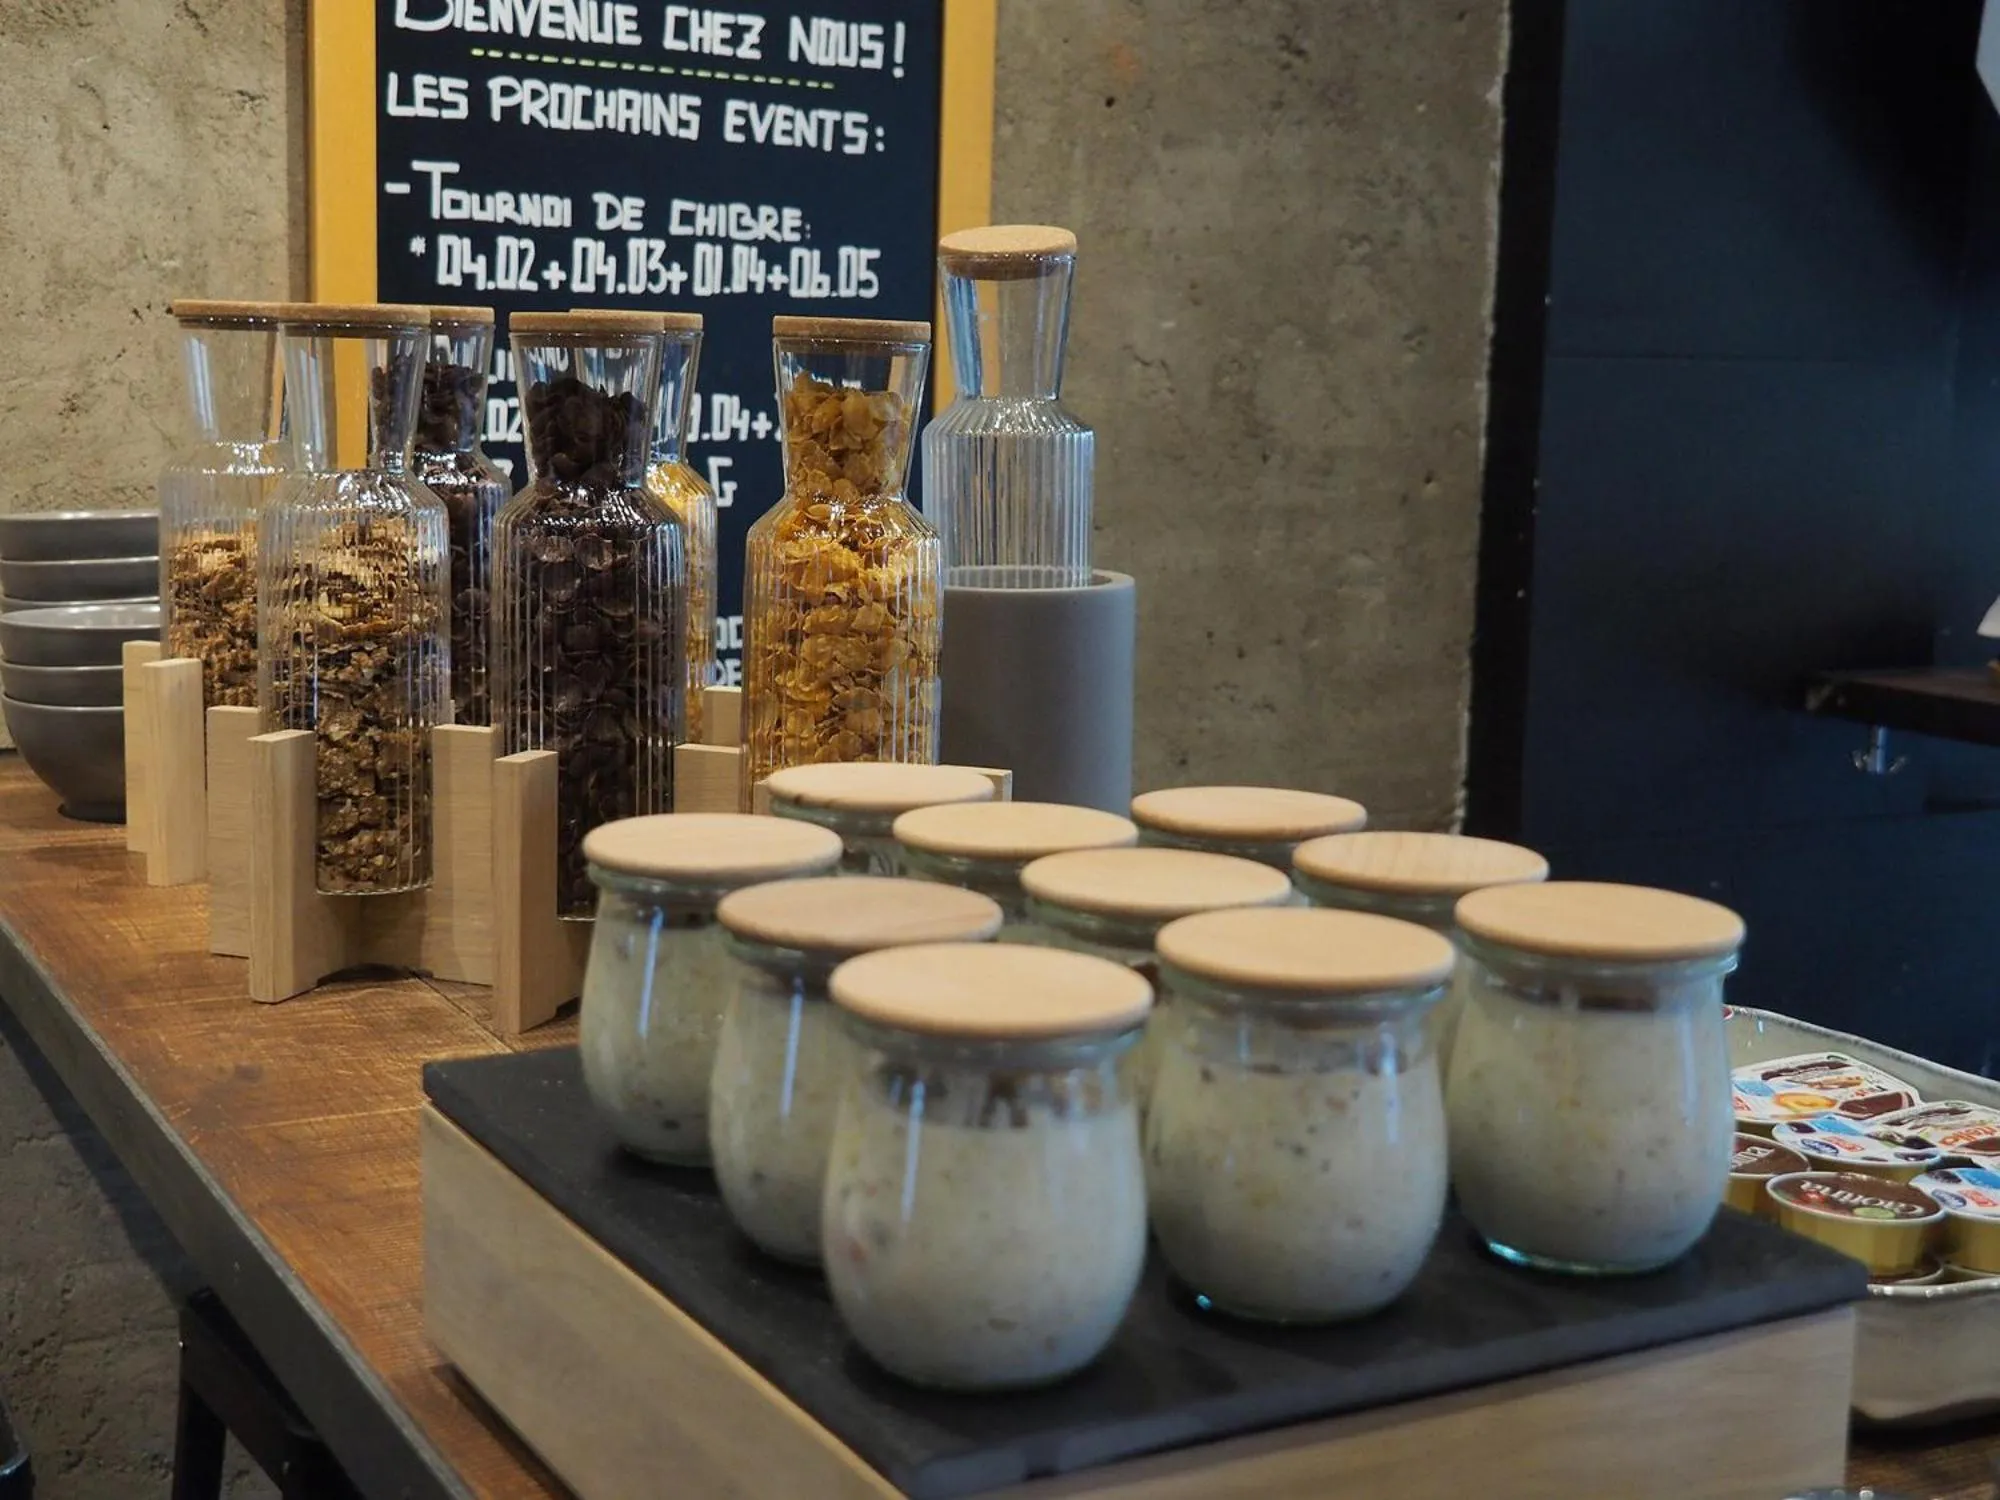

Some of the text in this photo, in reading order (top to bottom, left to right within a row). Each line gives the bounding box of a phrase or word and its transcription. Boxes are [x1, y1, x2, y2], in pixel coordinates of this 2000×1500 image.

[663, 4, 766, 60] CHEZ
[788, 15, 906, 79] NOUS!
[387, 71, 885, 155] LES PROCHAINS EVENTS:
[592, 191, 644, 232] DE
[668, 198, 811, 243] CHIBRE:
